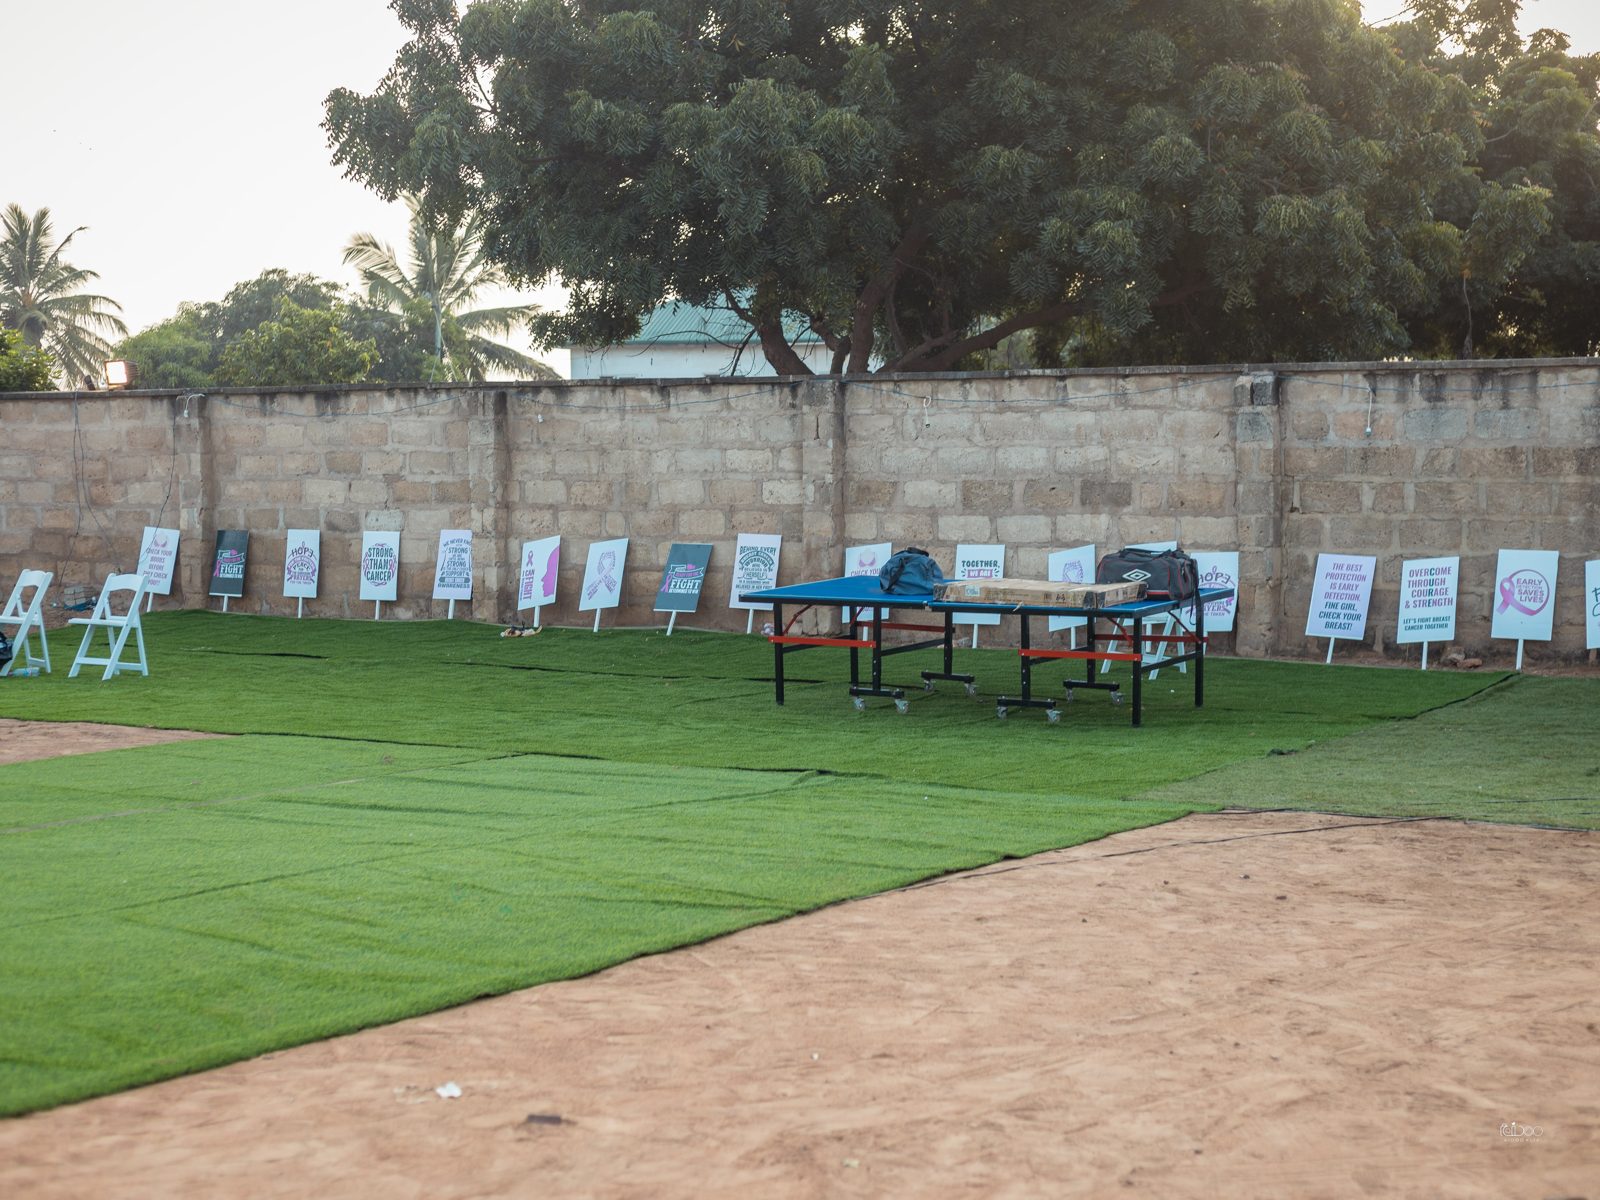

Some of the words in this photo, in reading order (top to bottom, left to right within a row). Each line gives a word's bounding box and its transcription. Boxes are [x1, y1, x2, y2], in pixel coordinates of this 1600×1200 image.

[368, 547, 394, 558] STRONG
[220, 564, 244, 574] FIGHT
[370, 558, 388, 570] THAN
[1332, 562, 1344, 571] THE
[1346, 563, 1363, 572] BEST
[366, 571, 392, 581] CANCER
[870, 568, 880, 576] YOU
[1325, 572, 1366, 582] PROTECTION
[1409, 566, 1452, 578] OVERCOME
[670, 580, 702, 589] FIGHT
[1338, 583, 1360, 592] EARLY
[1408, 578, 1446, 588] THROUGH
[1412, 587, 1449, 598] COURAGE
[1324, 601, 1340, 610] FINE
[1340, 602, 1358, 612] GIRL,
[1412, 597, 1454, 608] STRENGTH
[1318, 611, 1342, 620] CHECK
[1342, 612, 1362, 622] YOUR
[1324, 621, 1353, 631] BREAST!
